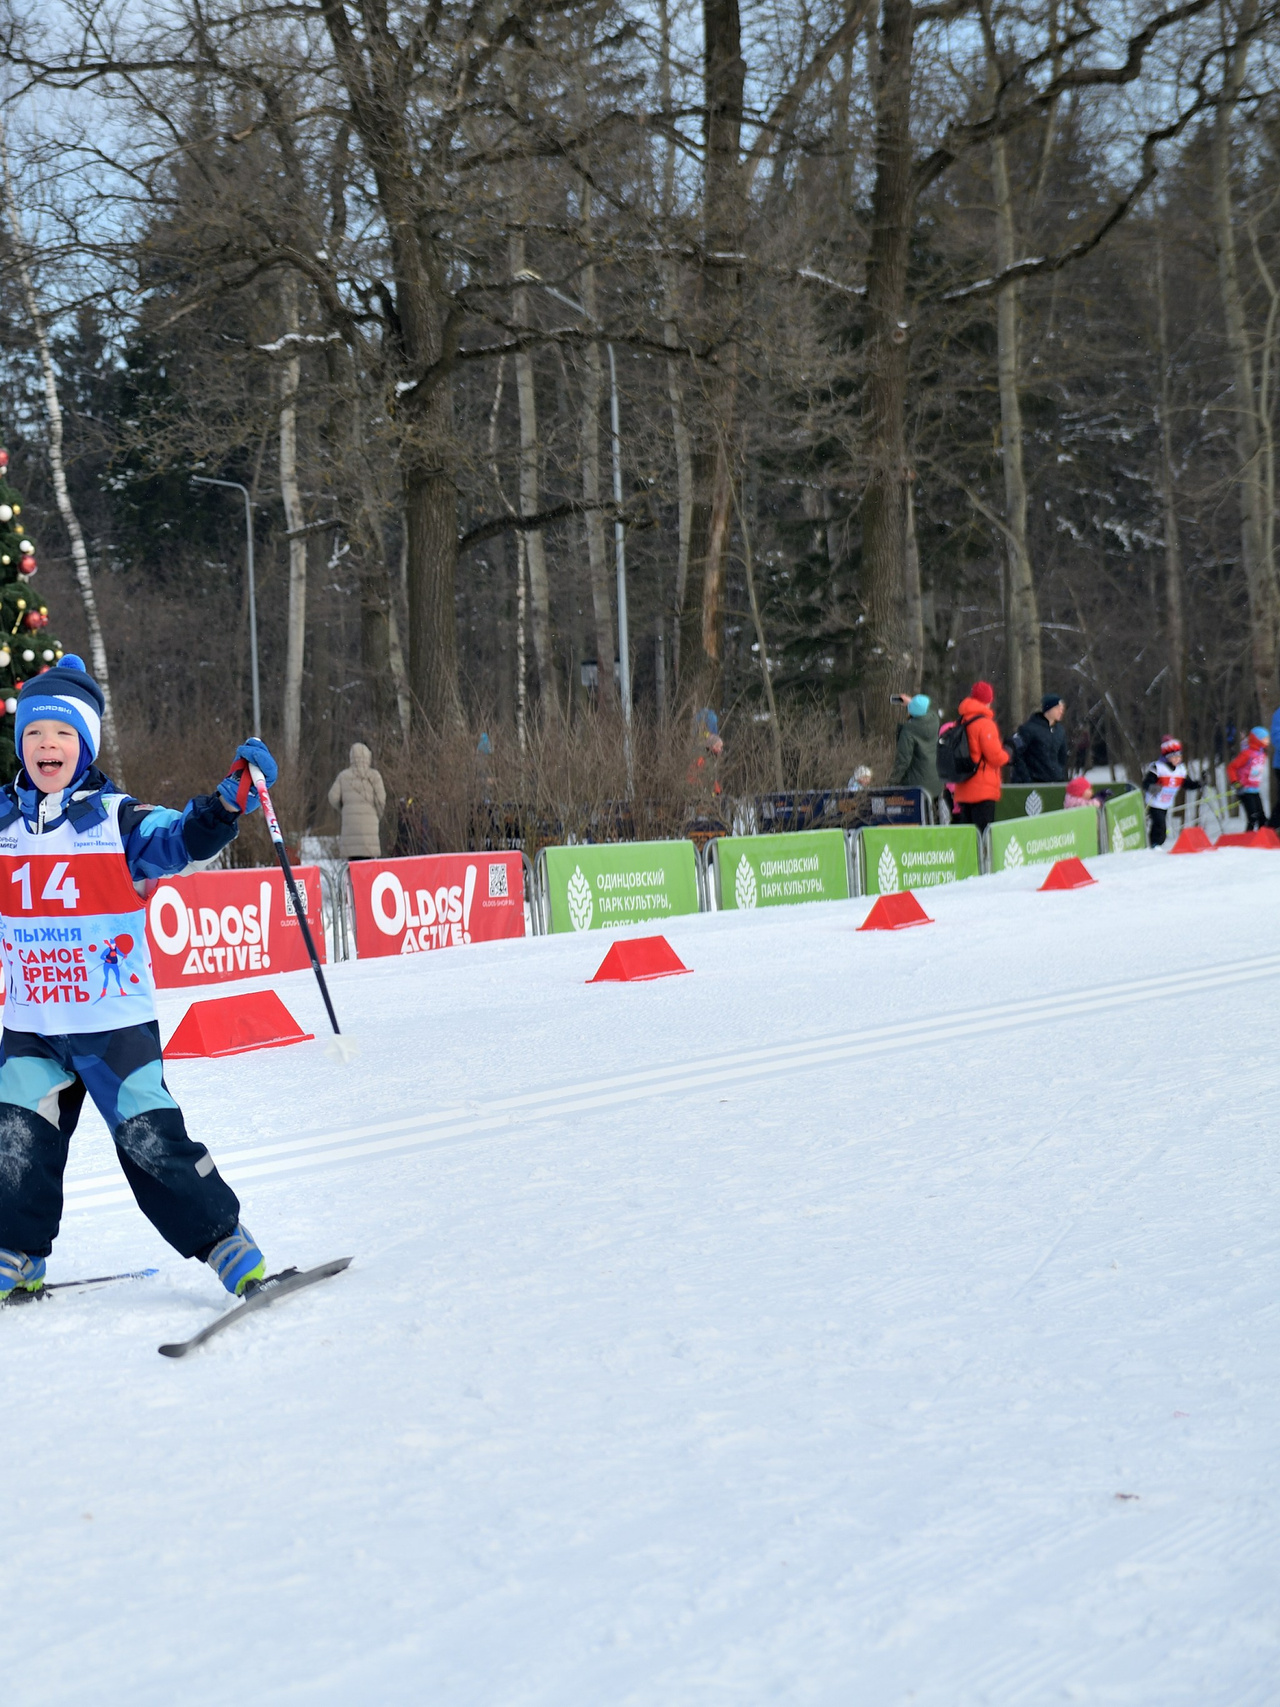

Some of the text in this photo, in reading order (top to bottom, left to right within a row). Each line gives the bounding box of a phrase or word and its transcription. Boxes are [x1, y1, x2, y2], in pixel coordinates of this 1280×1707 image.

[32, 705, 73, 715] NORDSKI
[760, 854, 819, 878] ОДИНЦОВСКИЙ
[11, 862, 80, 910] 14
[596, 868, 665, 892] ОДИНЦОВСКИЙ
[761, 878, 825, 898] ПАРК КУЛЬТУРЫ,
[599, 893, 672, 913] ПАРК КУЛЬТУРЫ,
